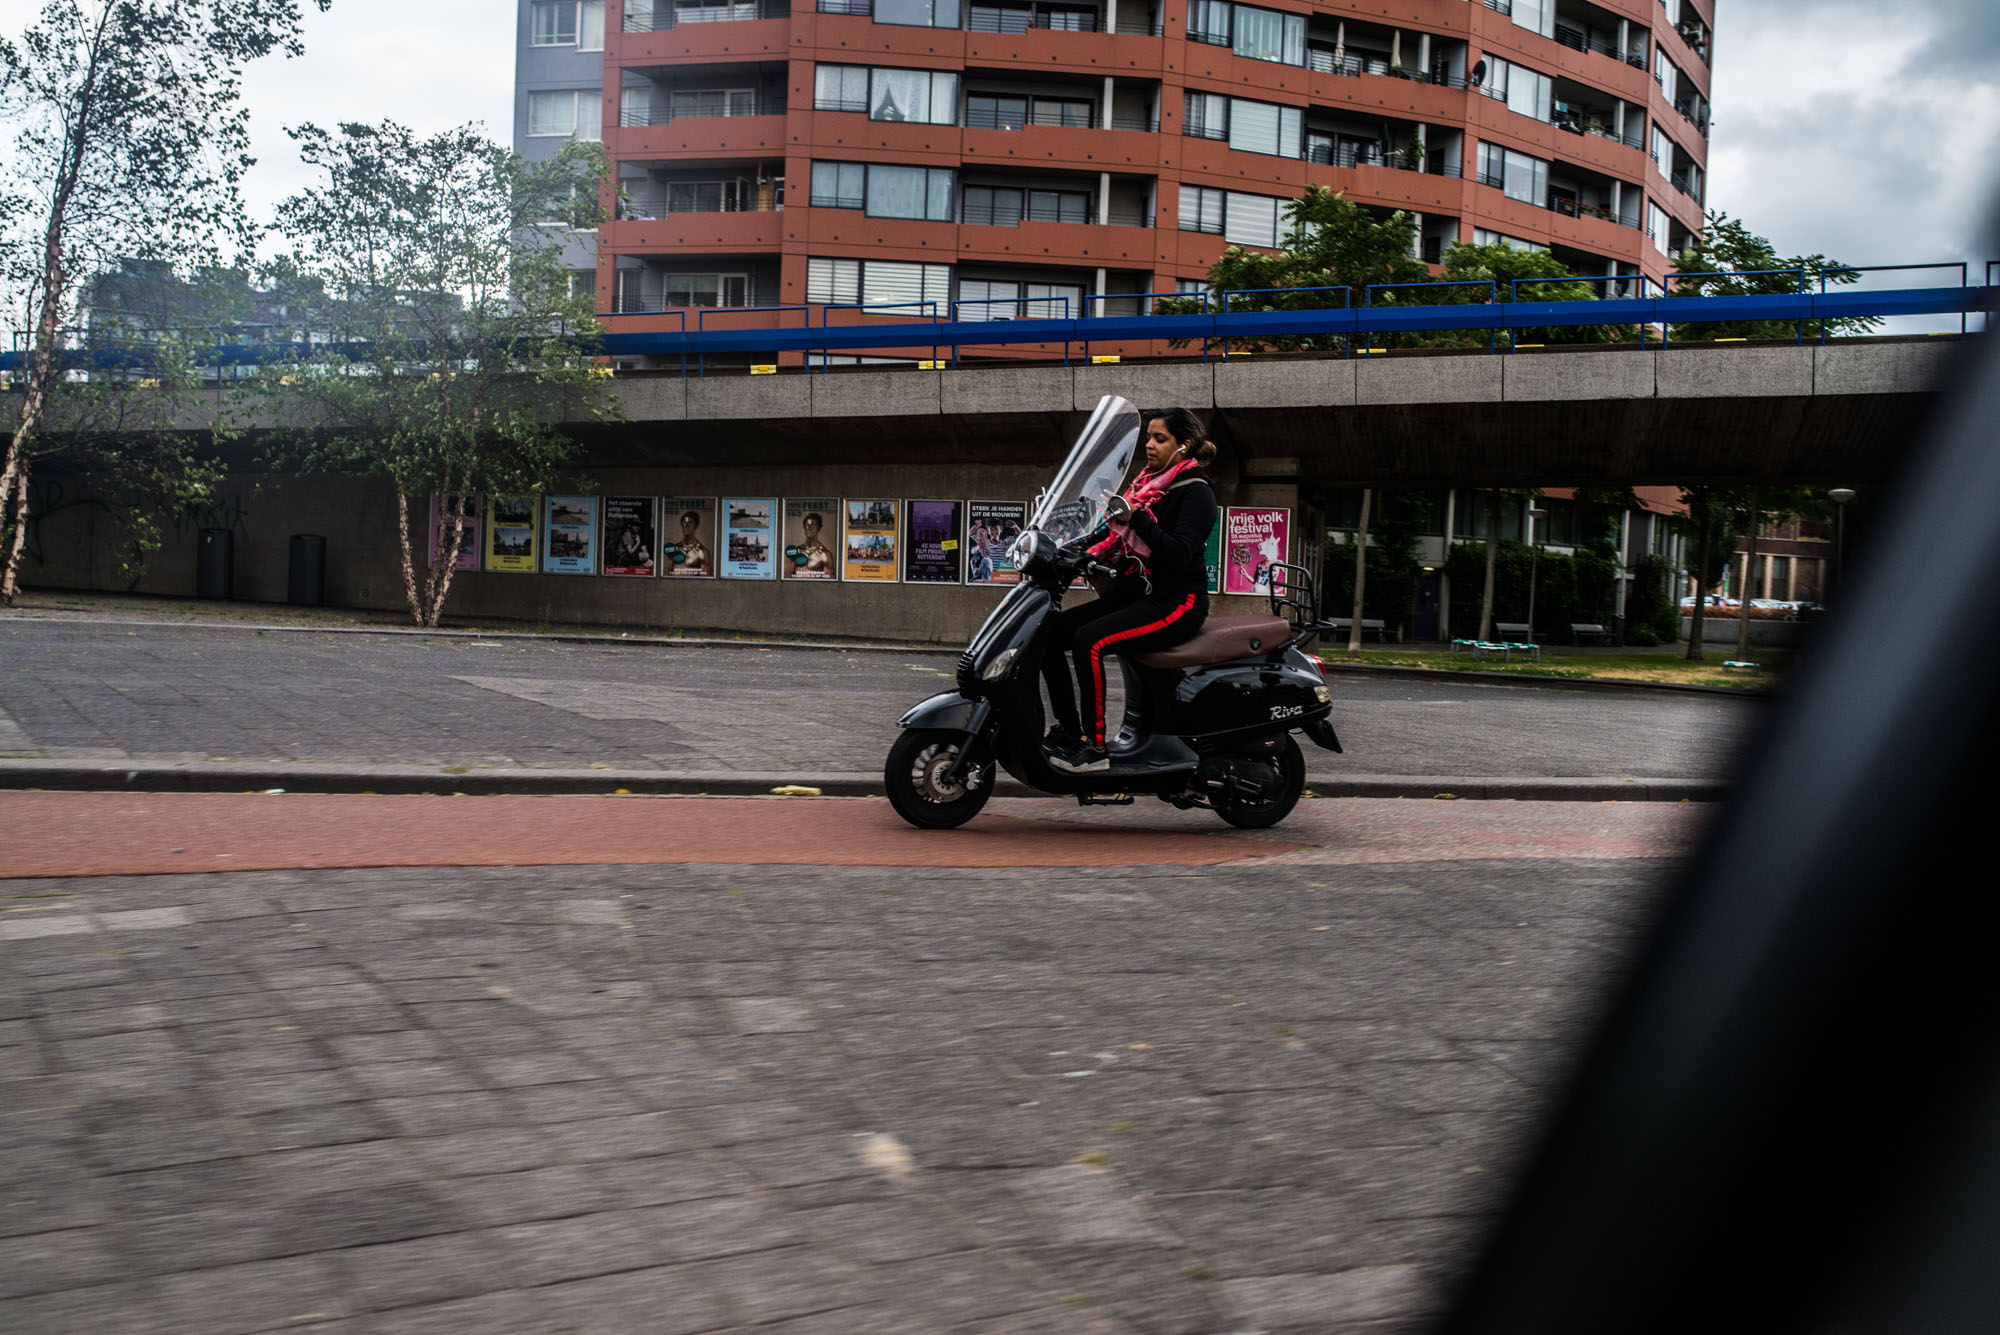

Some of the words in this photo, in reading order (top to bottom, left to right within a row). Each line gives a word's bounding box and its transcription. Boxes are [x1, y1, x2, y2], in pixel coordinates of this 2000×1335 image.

[1229, 513, 1255, 527] vrije
[1257, 512, 1283, 523] volk
[1230, 522, 1273, 534] festival
[1269, 705, 1304, 720] Riva
